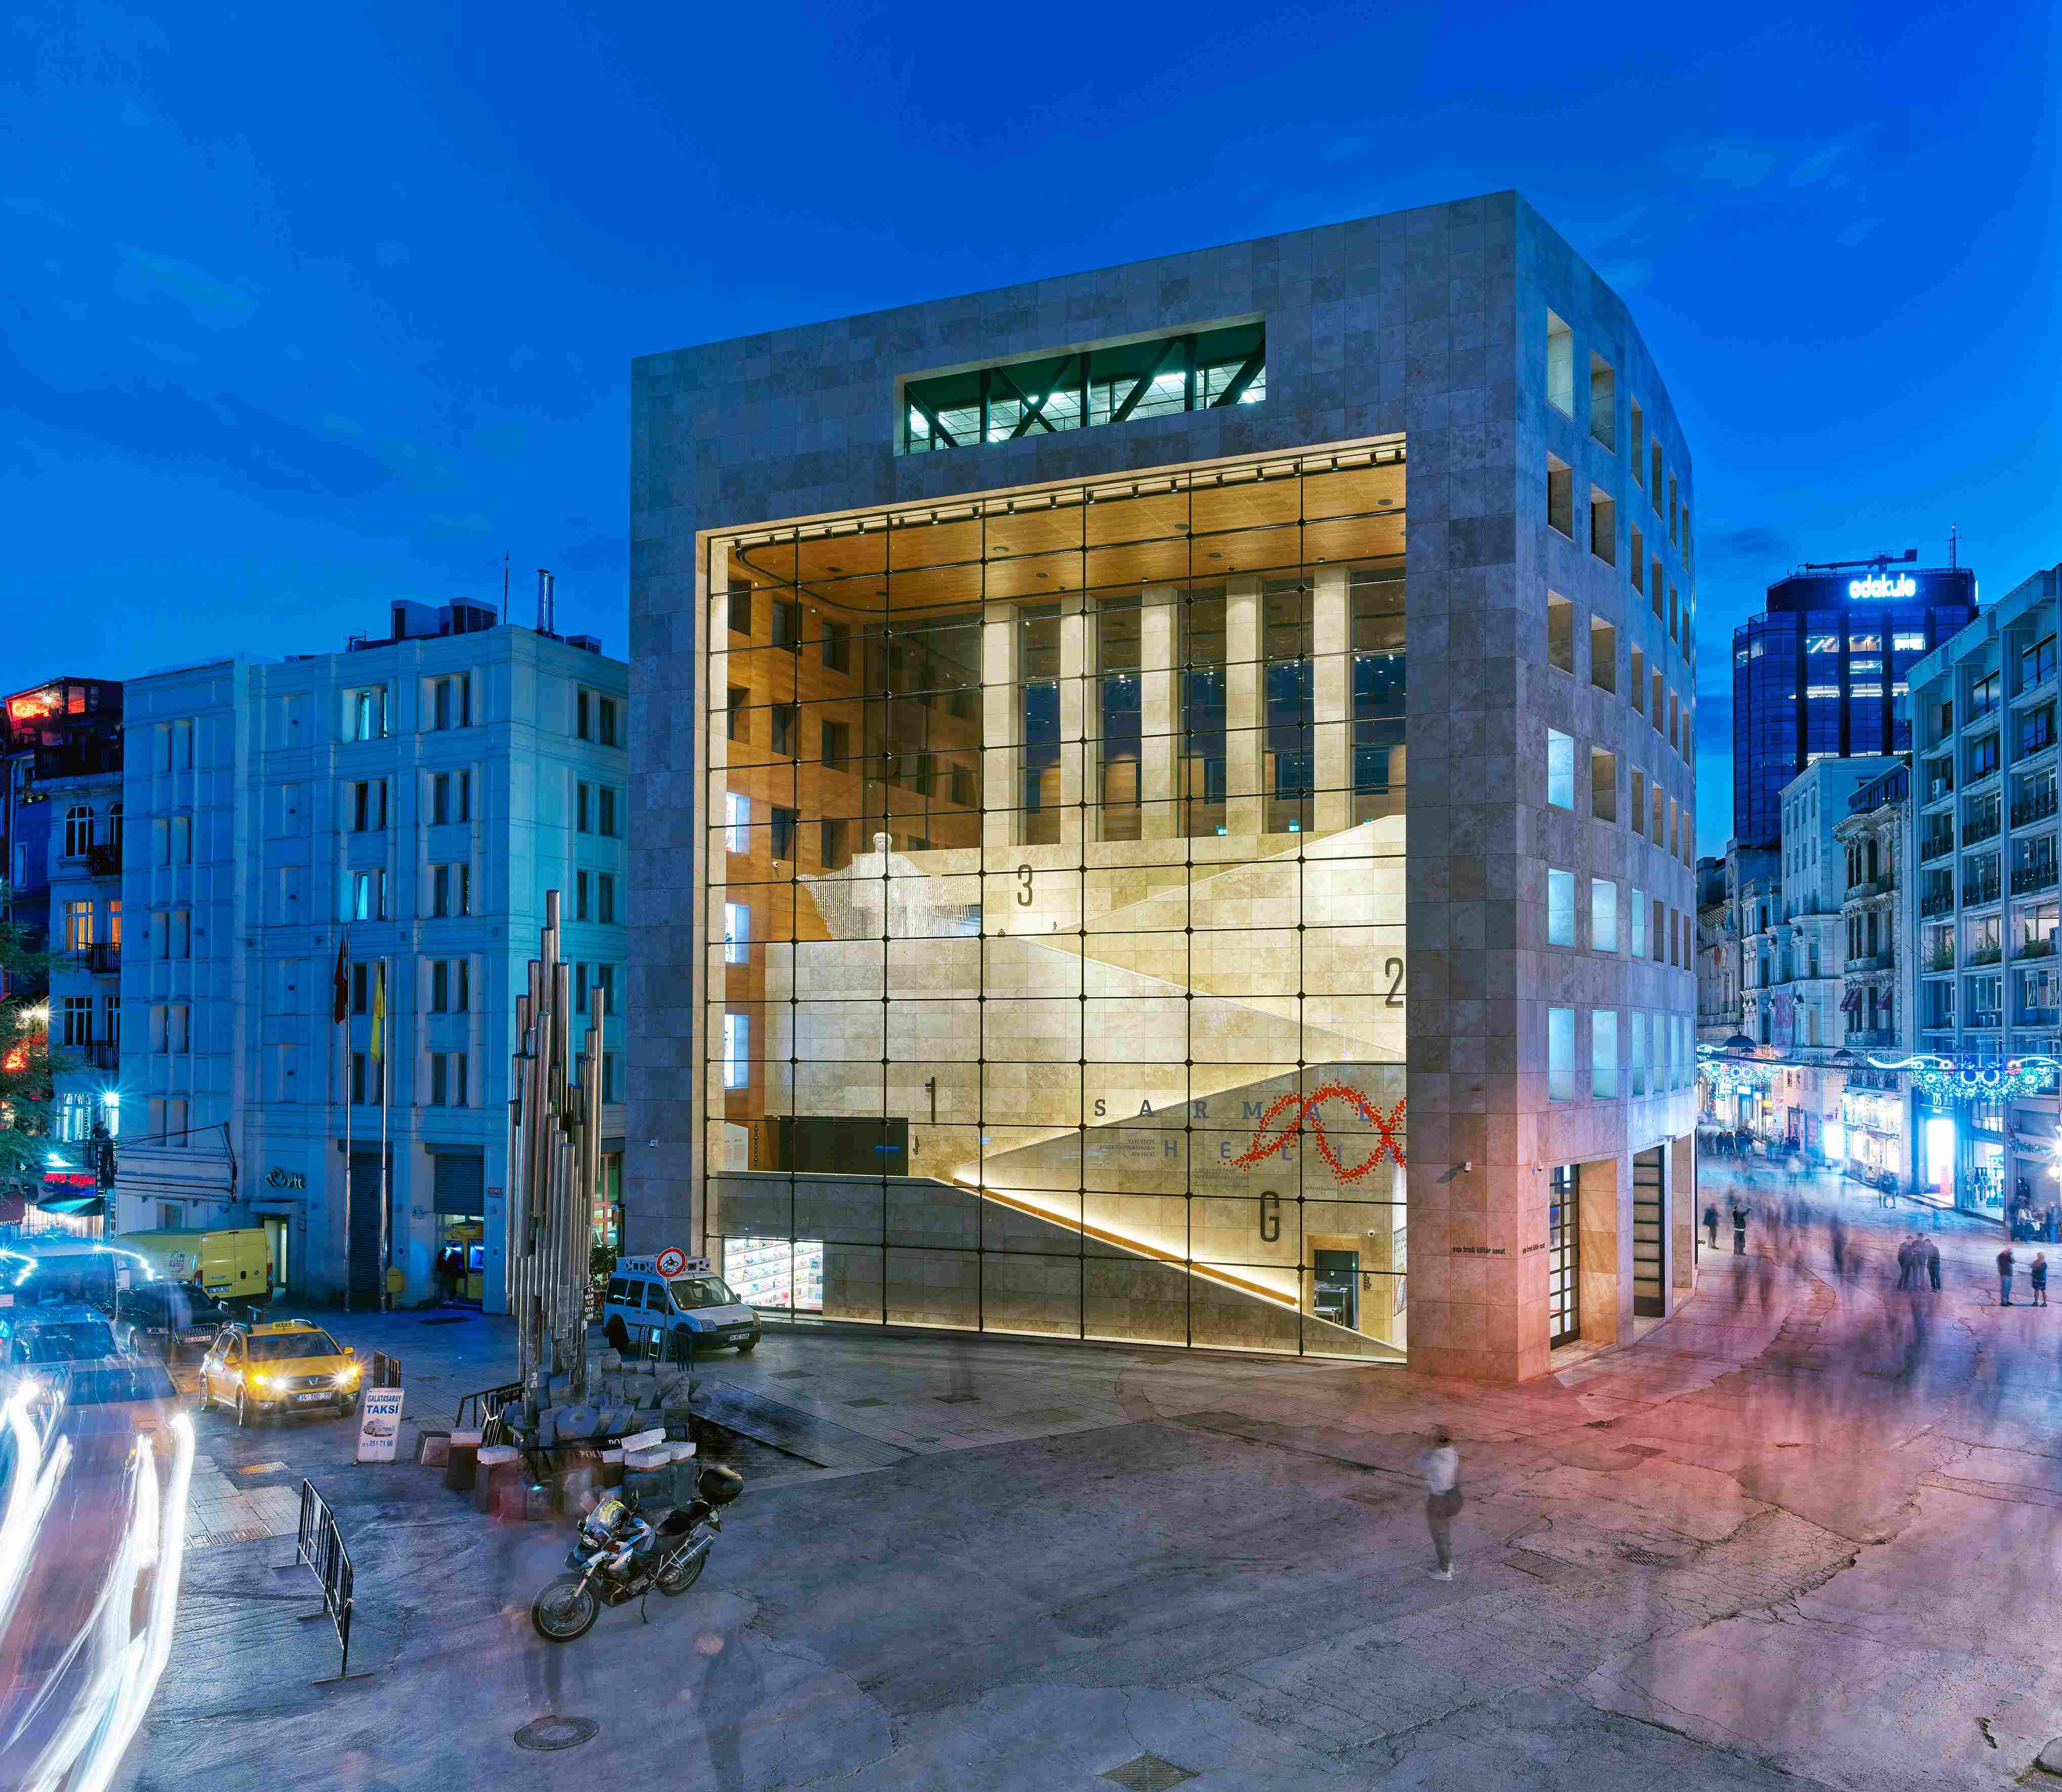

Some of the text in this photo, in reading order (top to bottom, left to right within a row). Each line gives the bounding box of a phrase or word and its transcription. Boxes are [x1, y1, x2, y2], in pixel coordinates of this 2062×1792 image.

[1849, 574, 1916, 599] odakule
[1017, 864, 1033, 907] 3
[1385, 957, 1404, 1008] 2
[925, 1076, 935, 1127] 1
[1094, 1098, 1373, 1122] SARMAL
[1260, 1191, 1279, 1243] G
[367, 1403, 399, 1414] TAKSİ
[368, 1394, 402, 1403] GALATASARAY
